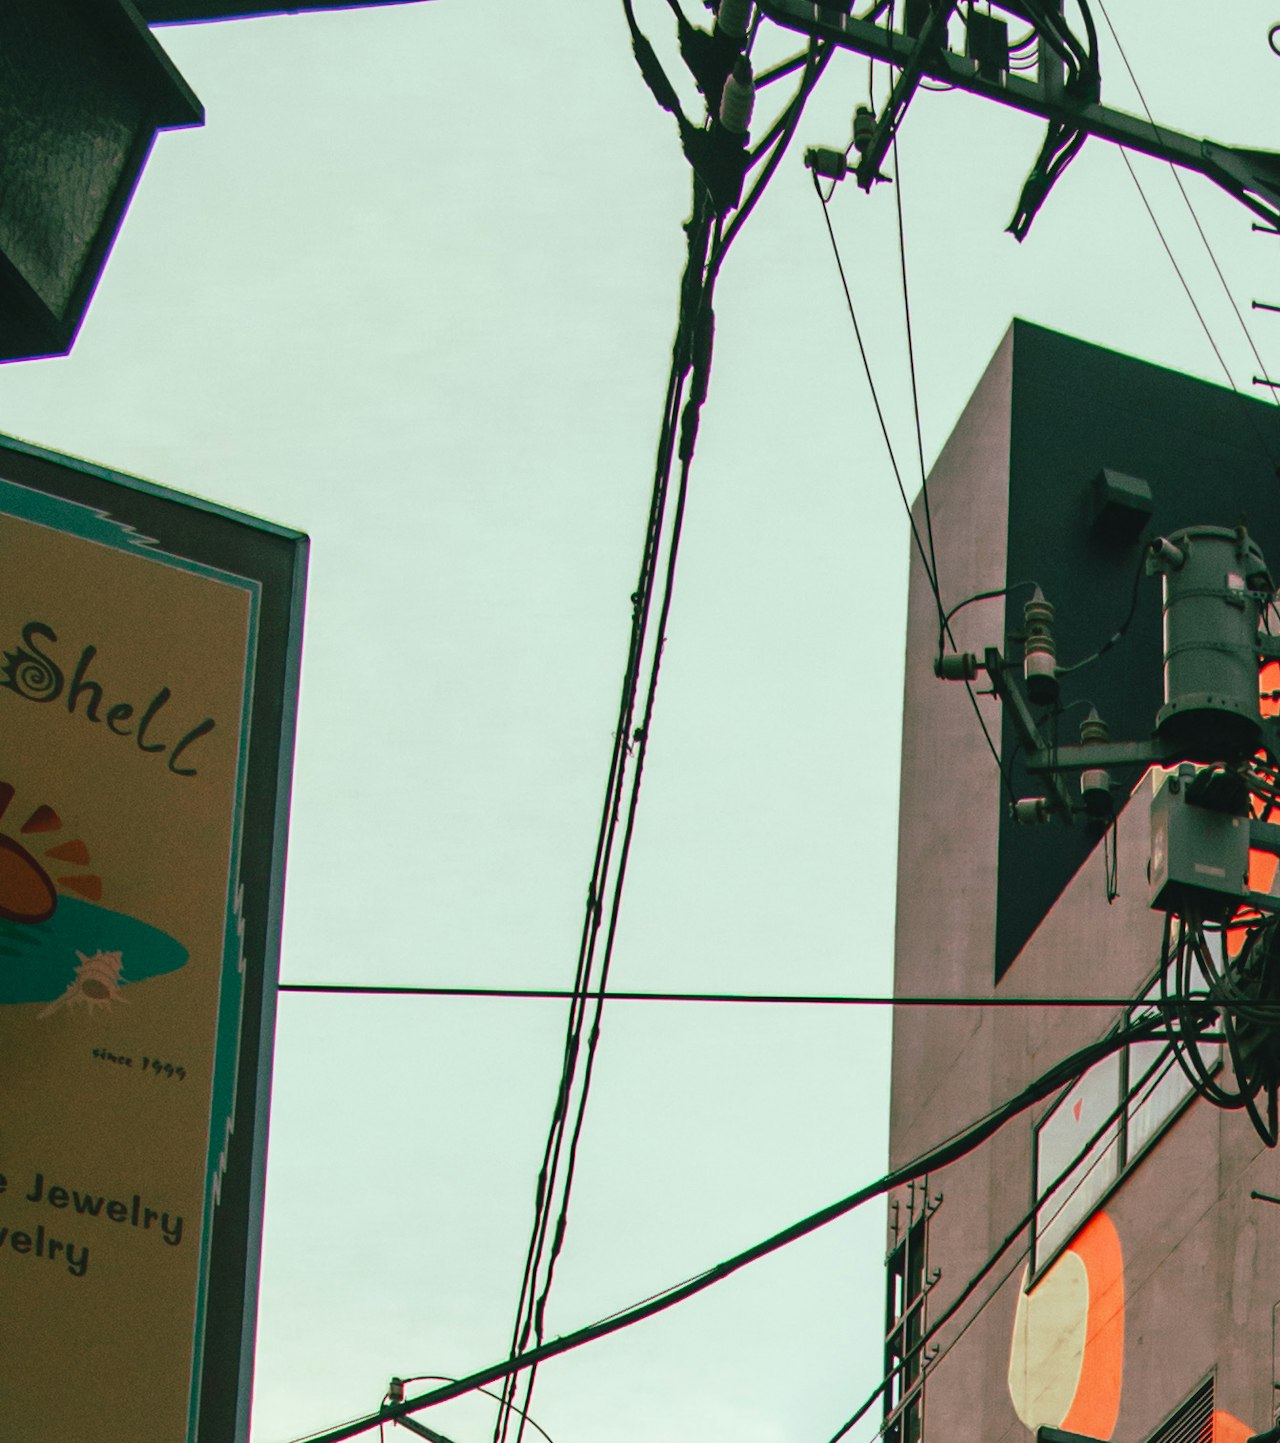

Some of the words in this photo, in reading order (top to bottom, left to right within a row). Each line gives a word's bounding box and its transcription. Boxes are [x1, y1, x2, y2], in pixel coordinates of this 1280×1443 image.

[2, 622, 216, 777] Shell
[92, 1047, 133, 1067] since
[141, 1056, 187, 1081] 1999
[26, 1173, 185, 1246] Jewelry
